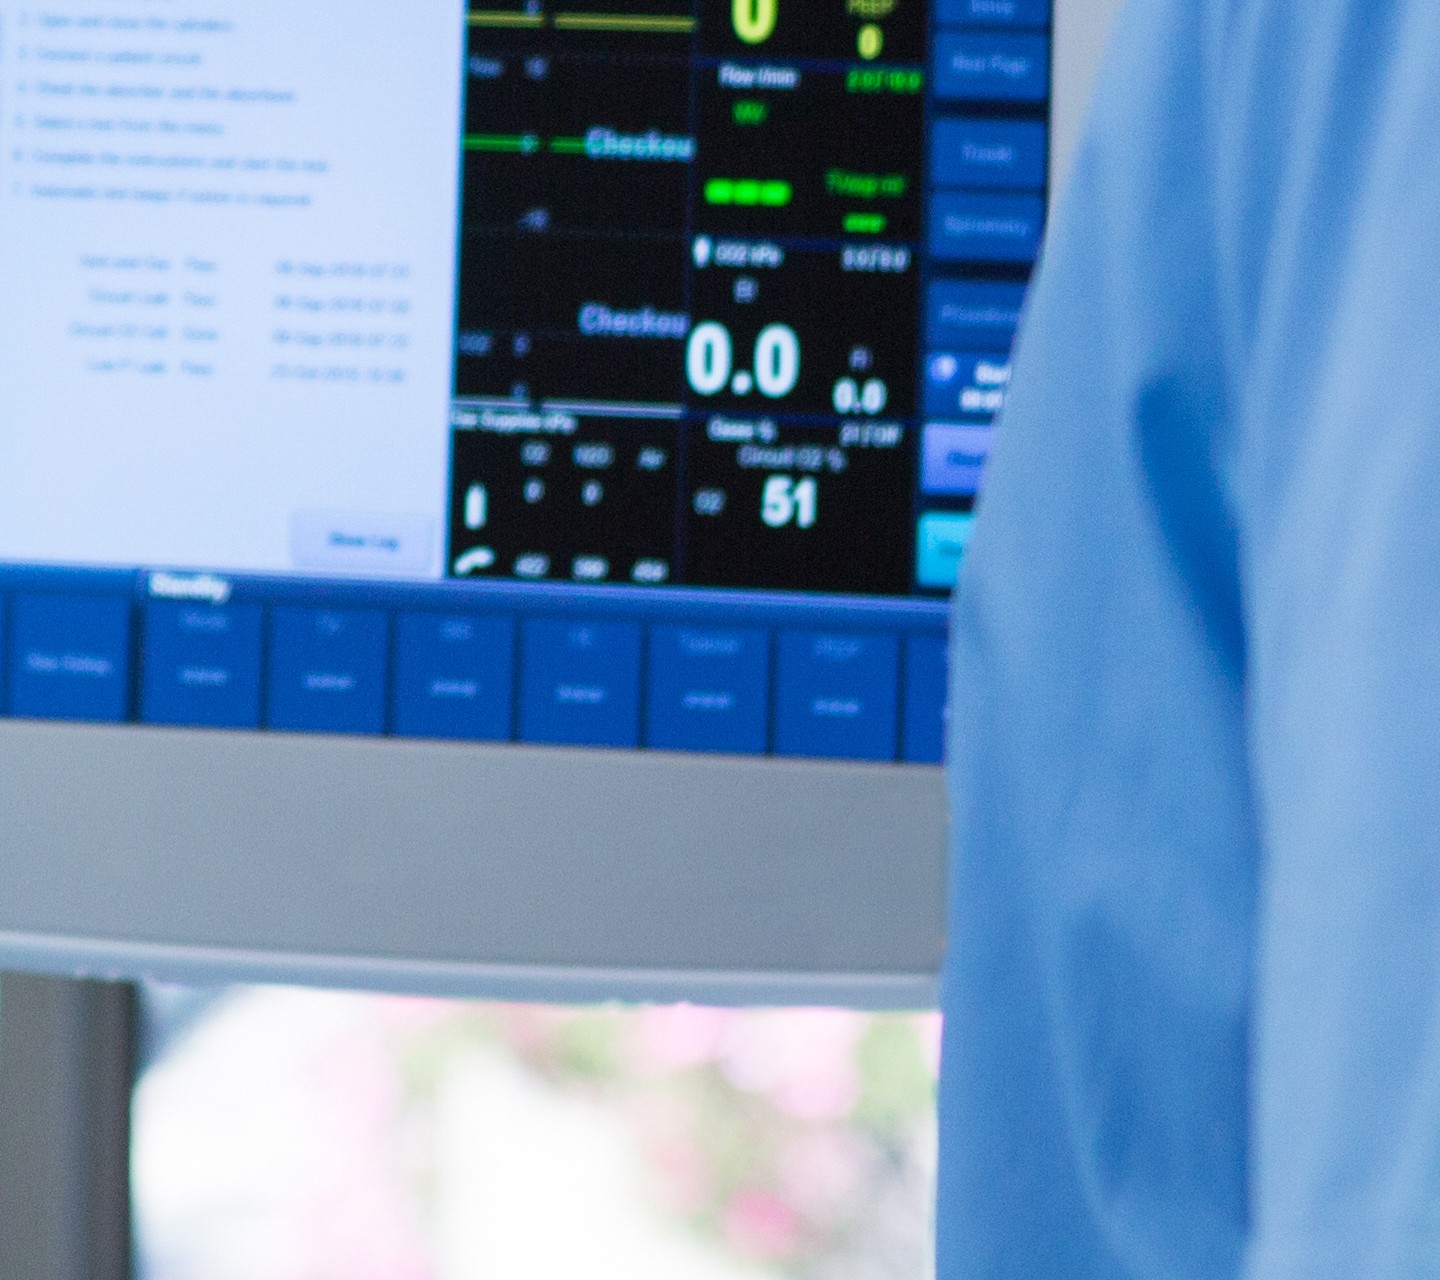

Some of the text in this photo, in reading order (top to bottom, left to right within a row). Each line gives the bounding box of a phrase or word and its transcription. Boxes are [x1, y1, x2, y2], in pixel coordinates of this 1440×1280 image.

[857, 24, 884, 60] 0
[686, 319, 802, 399] 0.0
[831, 376, 888, 416] 0.0
[761, 472, 819, 530] 51
